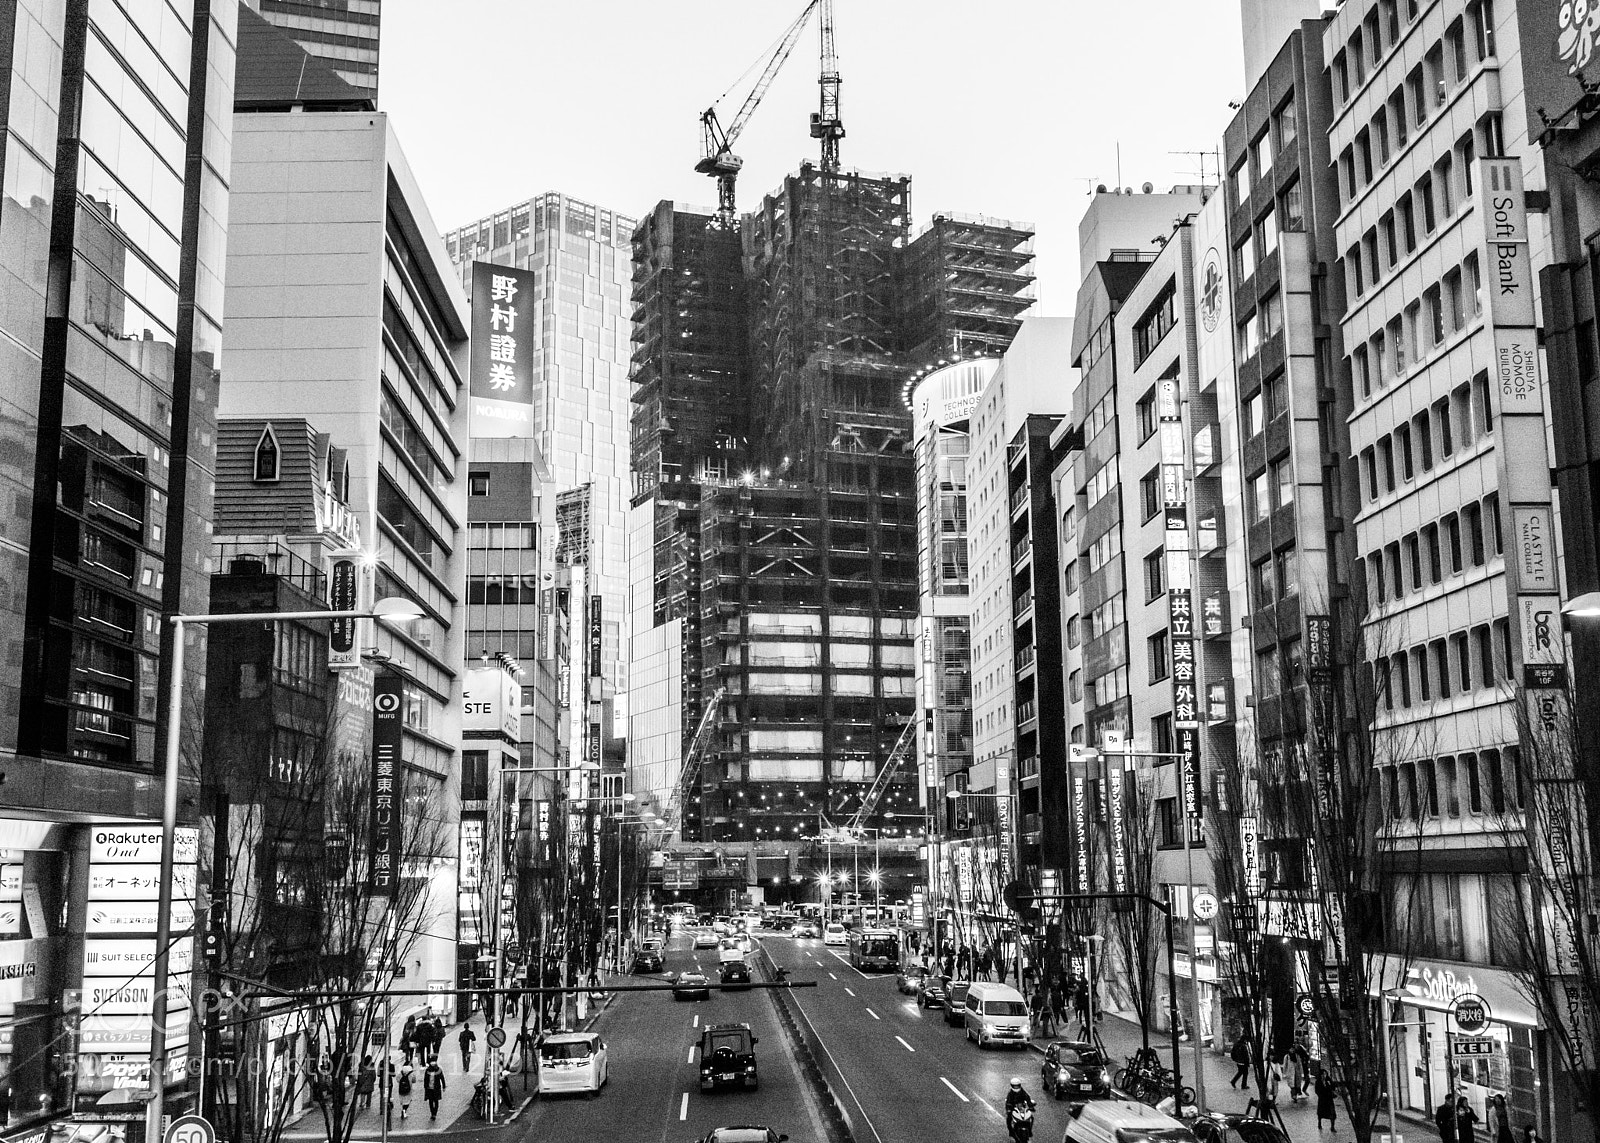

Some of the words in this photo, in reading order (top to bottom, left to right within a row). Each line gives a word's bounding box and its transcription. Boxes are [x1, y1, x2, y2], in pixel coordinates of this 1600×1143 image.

[489, 274, 518, 391] 野村證券
[1499, 348, 1512, 395] BUILDING
[1511, 343, 1526, 400] MOMOSE
[1524, 351, 1536, 392] SHIBUYA
[475, 404, 528, 422] NOMURA
[1530, 516, 1544, 581] CLASTYLE
[101, 953, 121, 961] SUIT
[93, 988, 149, 1003] SVENSON
[1457, 1008, 1484, 1022] 消火栓
[1457, 1042, 1489, 1053] KEN
